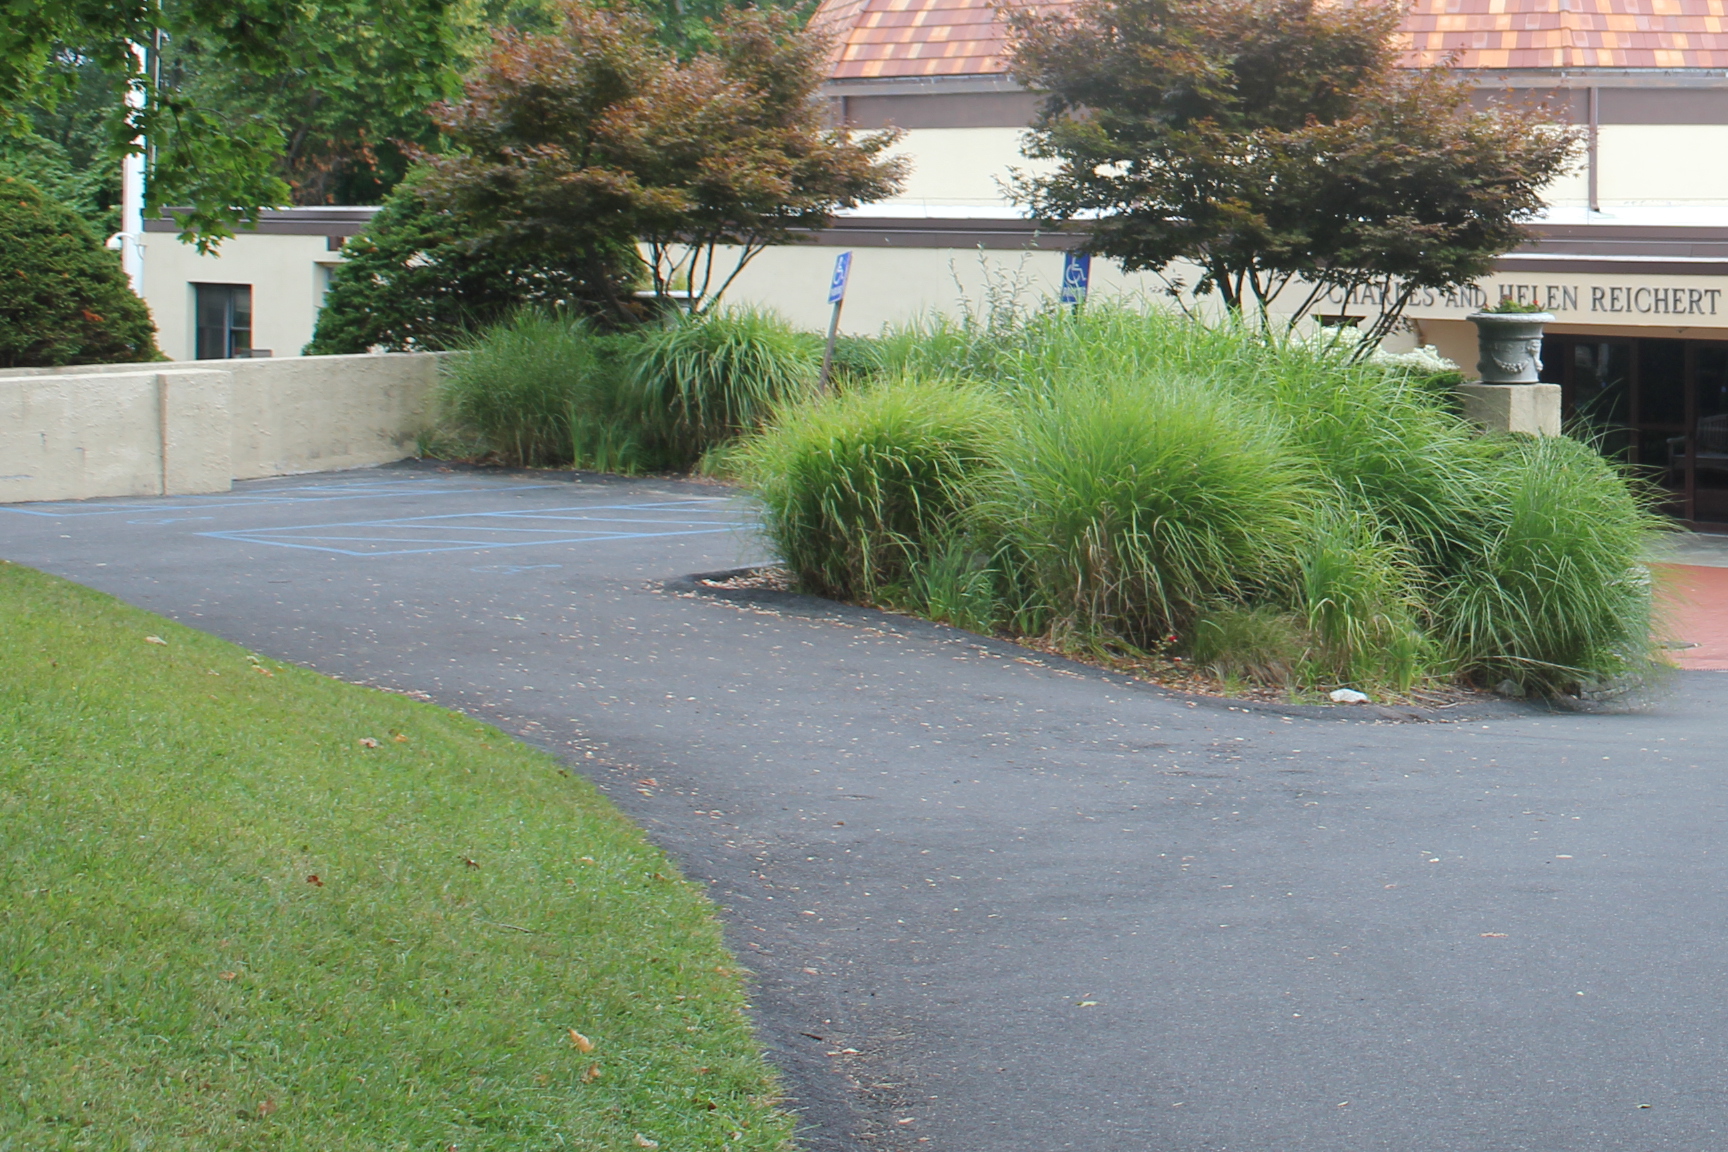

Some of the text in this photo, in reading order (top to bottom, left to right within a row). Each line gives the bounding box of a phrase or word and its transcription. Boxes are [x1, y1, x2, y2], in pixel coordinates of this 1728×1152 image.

[1444, 284, 1487, 308] AND
[1498, 284, 1578, 311] HELEN
[1591, 286, 1721, 315] REICHERT
